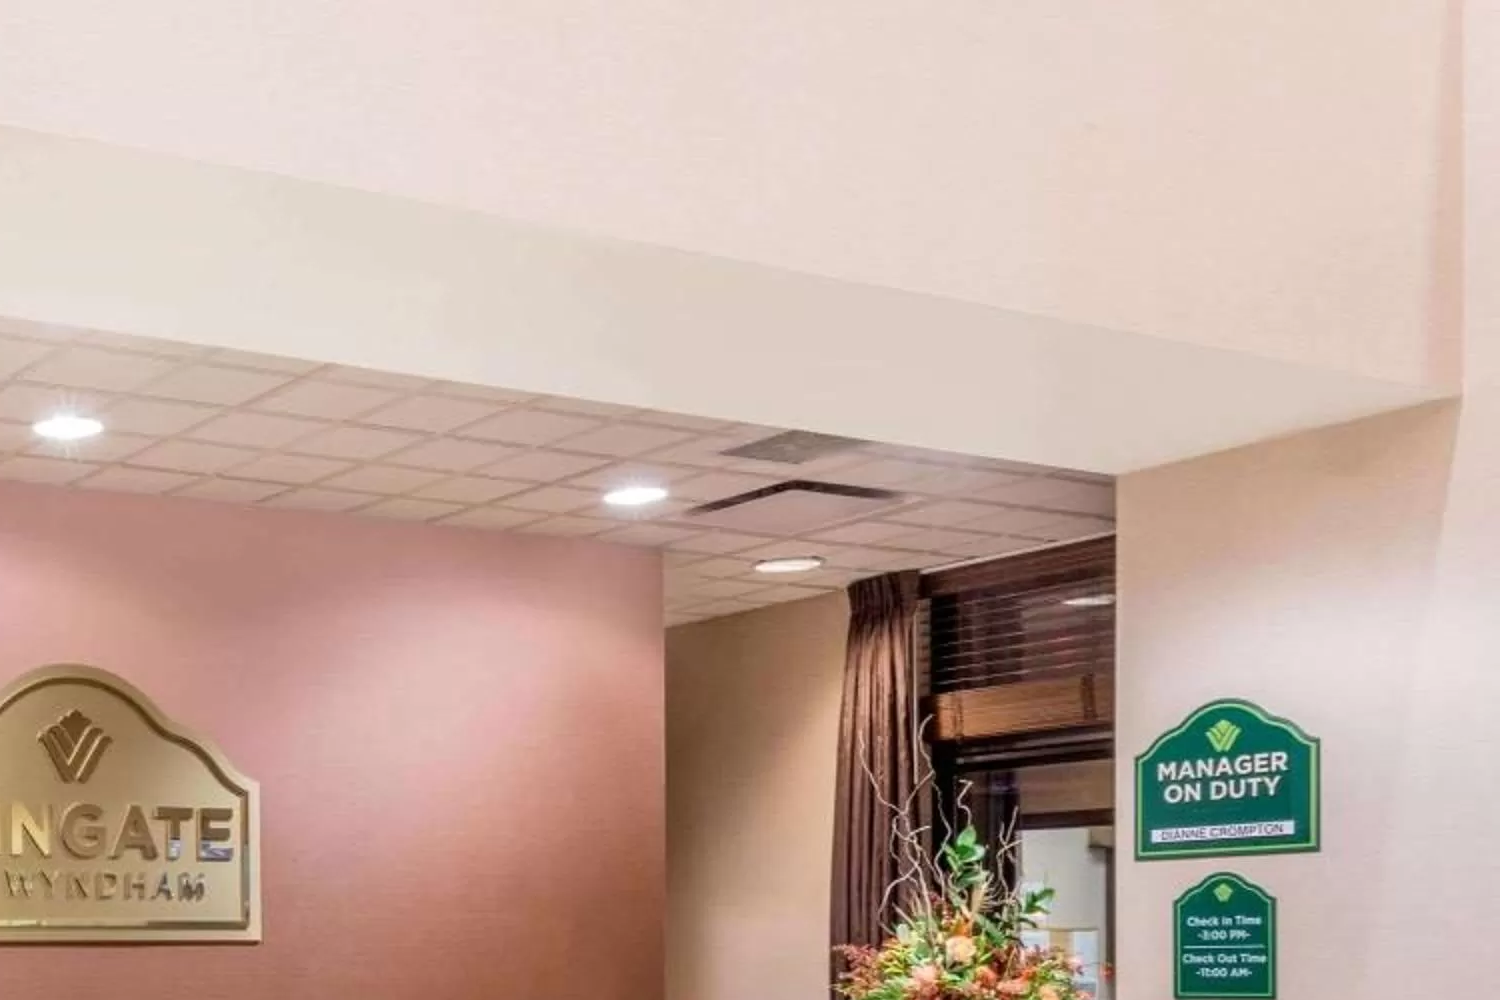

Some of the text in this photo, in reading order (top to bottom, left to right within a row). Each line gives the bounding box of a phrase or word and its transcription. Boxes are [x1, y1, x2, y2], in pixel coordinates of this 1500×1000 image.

[1157, 751, 1288, 782] MANAGER
[1164, 775, 1282, 804] ON DUTY
[1161, 822, 1284, 841] DIANNE CROMPTON
[4, 869, 206, 902] WYNDHAM
[1187, 916, 1218, 926] Check
[1234, 915, 1262, 925] Time
[1182, 953, 1267, 964] Check Out Time
